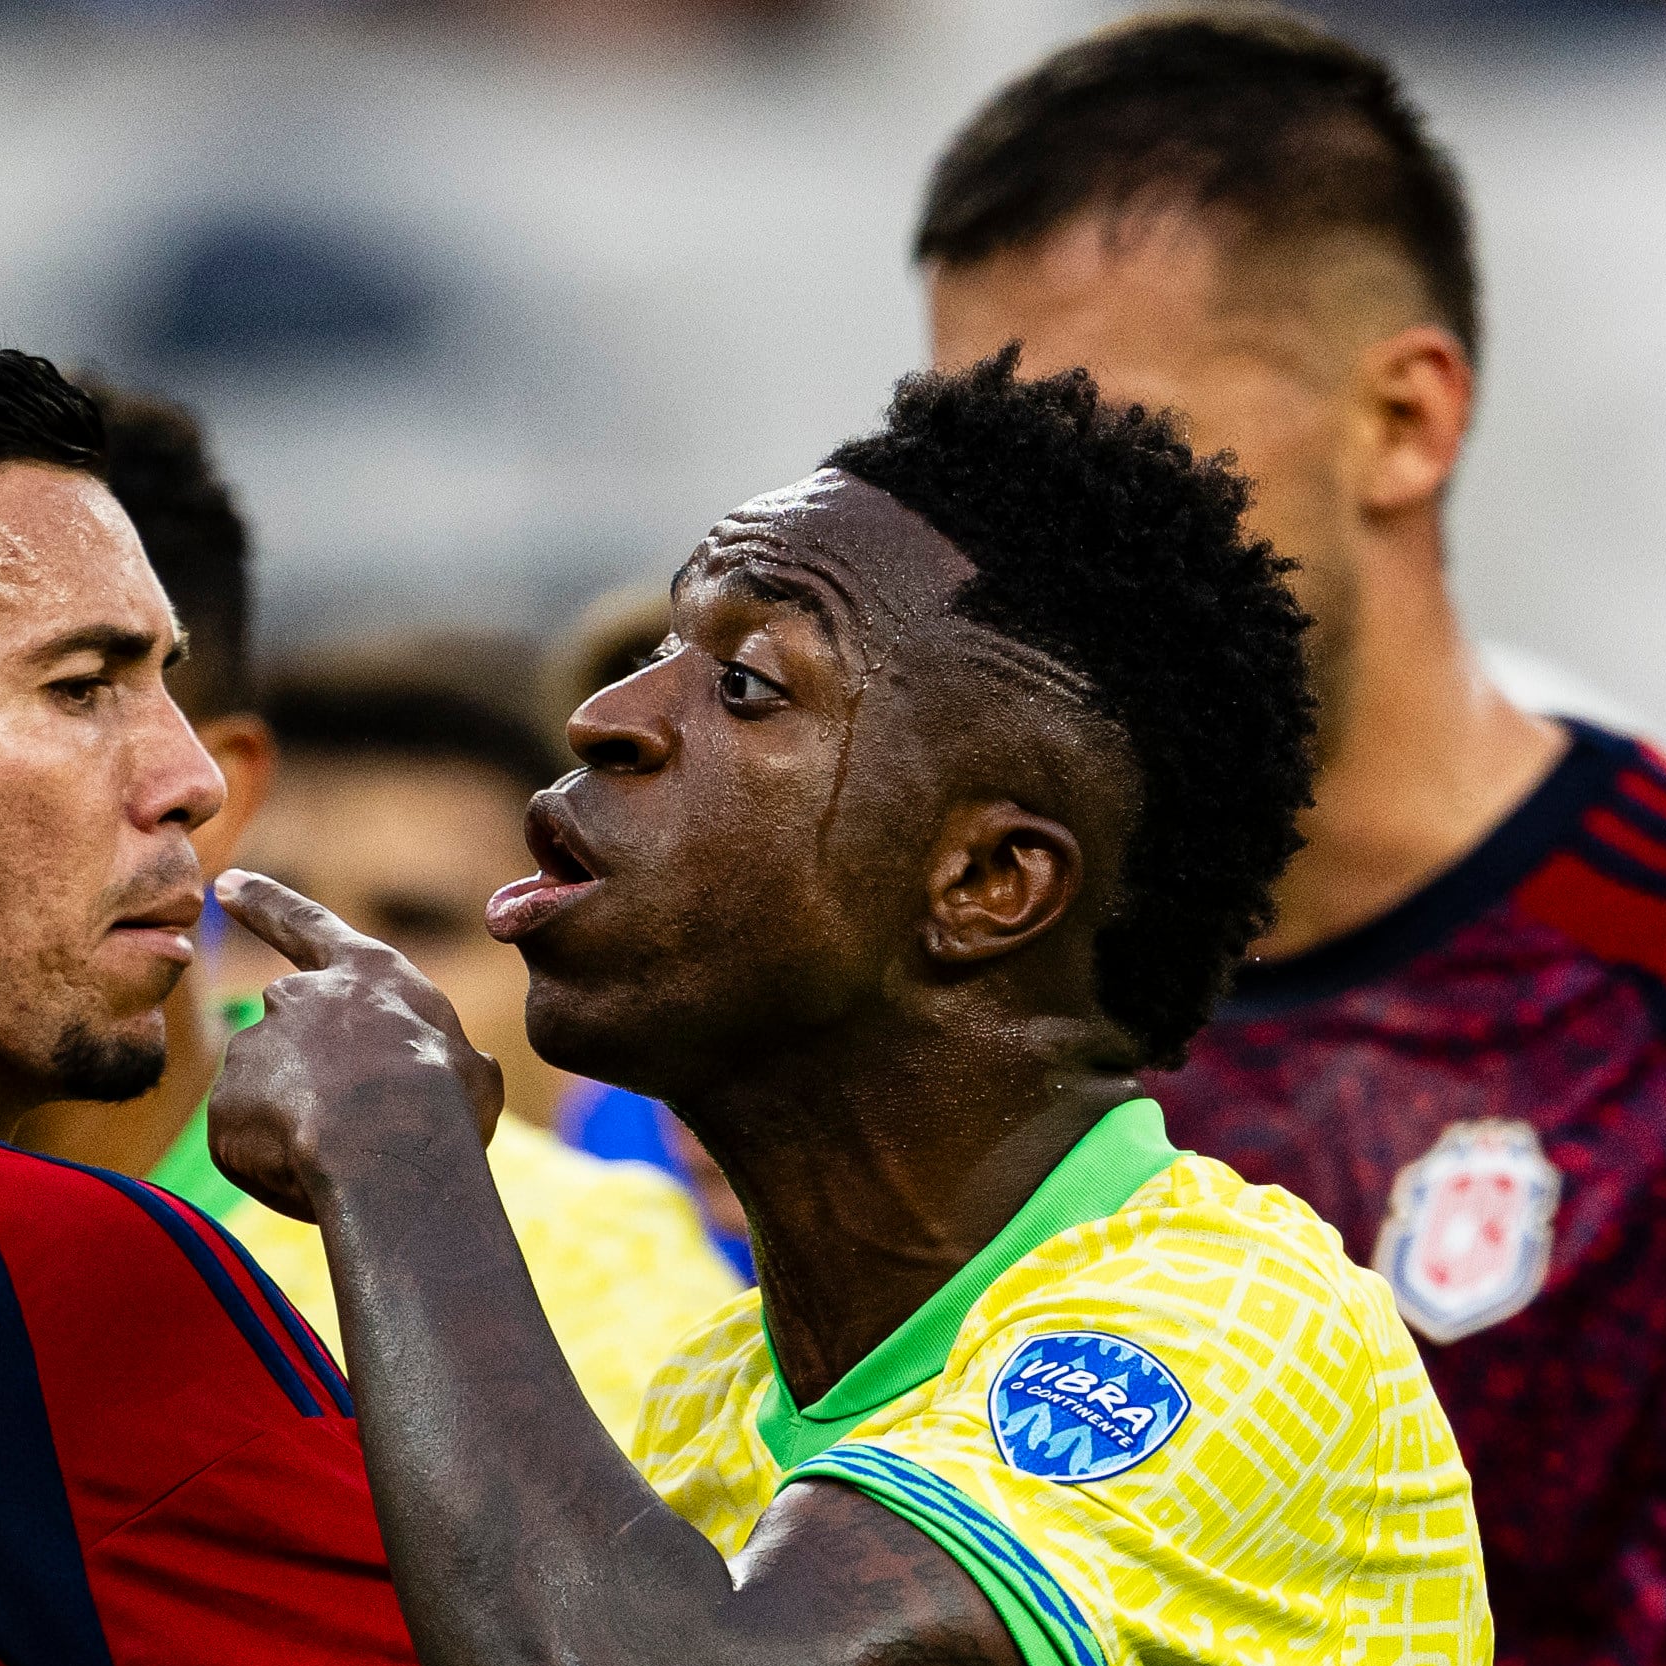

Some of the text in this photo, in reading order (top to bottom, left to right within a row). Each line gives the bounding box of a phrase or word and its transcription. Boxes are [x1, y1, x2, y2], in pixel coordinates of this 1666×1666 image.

[1010, 1382, 1136, 1449] O CONTINENTE
[1019, 1360, 1156, 1435] VIBRA
